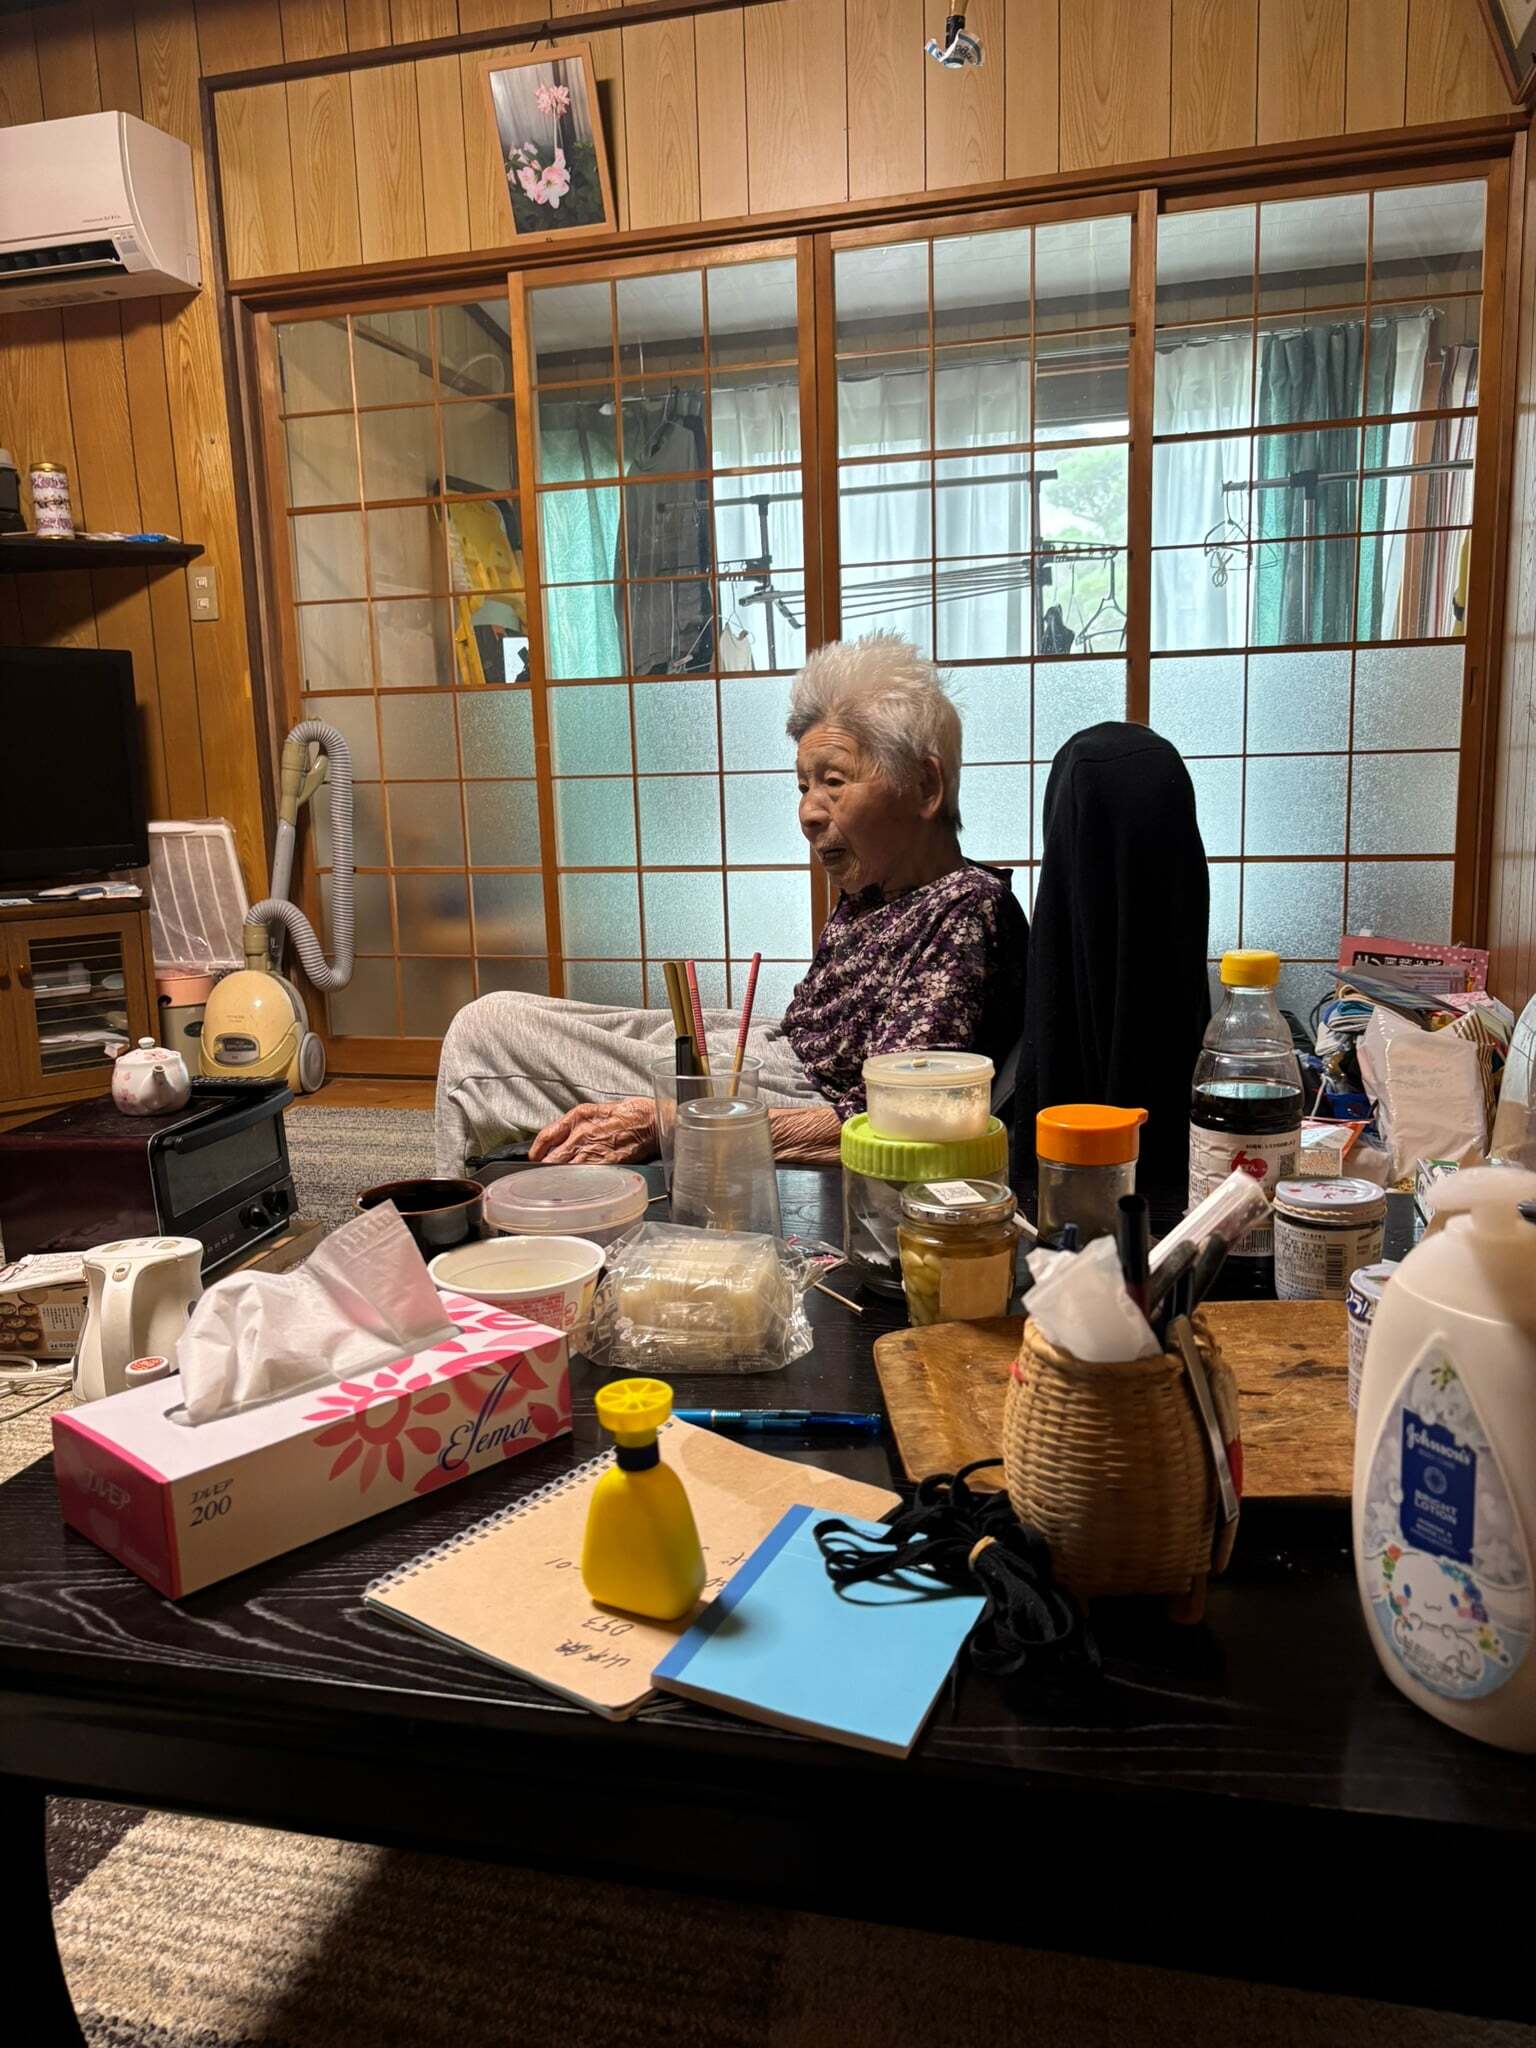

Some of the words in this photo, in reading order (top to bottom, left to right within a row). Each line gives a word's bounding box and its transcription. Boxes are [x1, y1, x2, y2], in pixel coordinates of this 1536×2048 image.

[81, 1469, 132, 1511] エルモア
[190, 1479, 234, 1506] エルモア
[189, 1496, 232, 1527] 200
